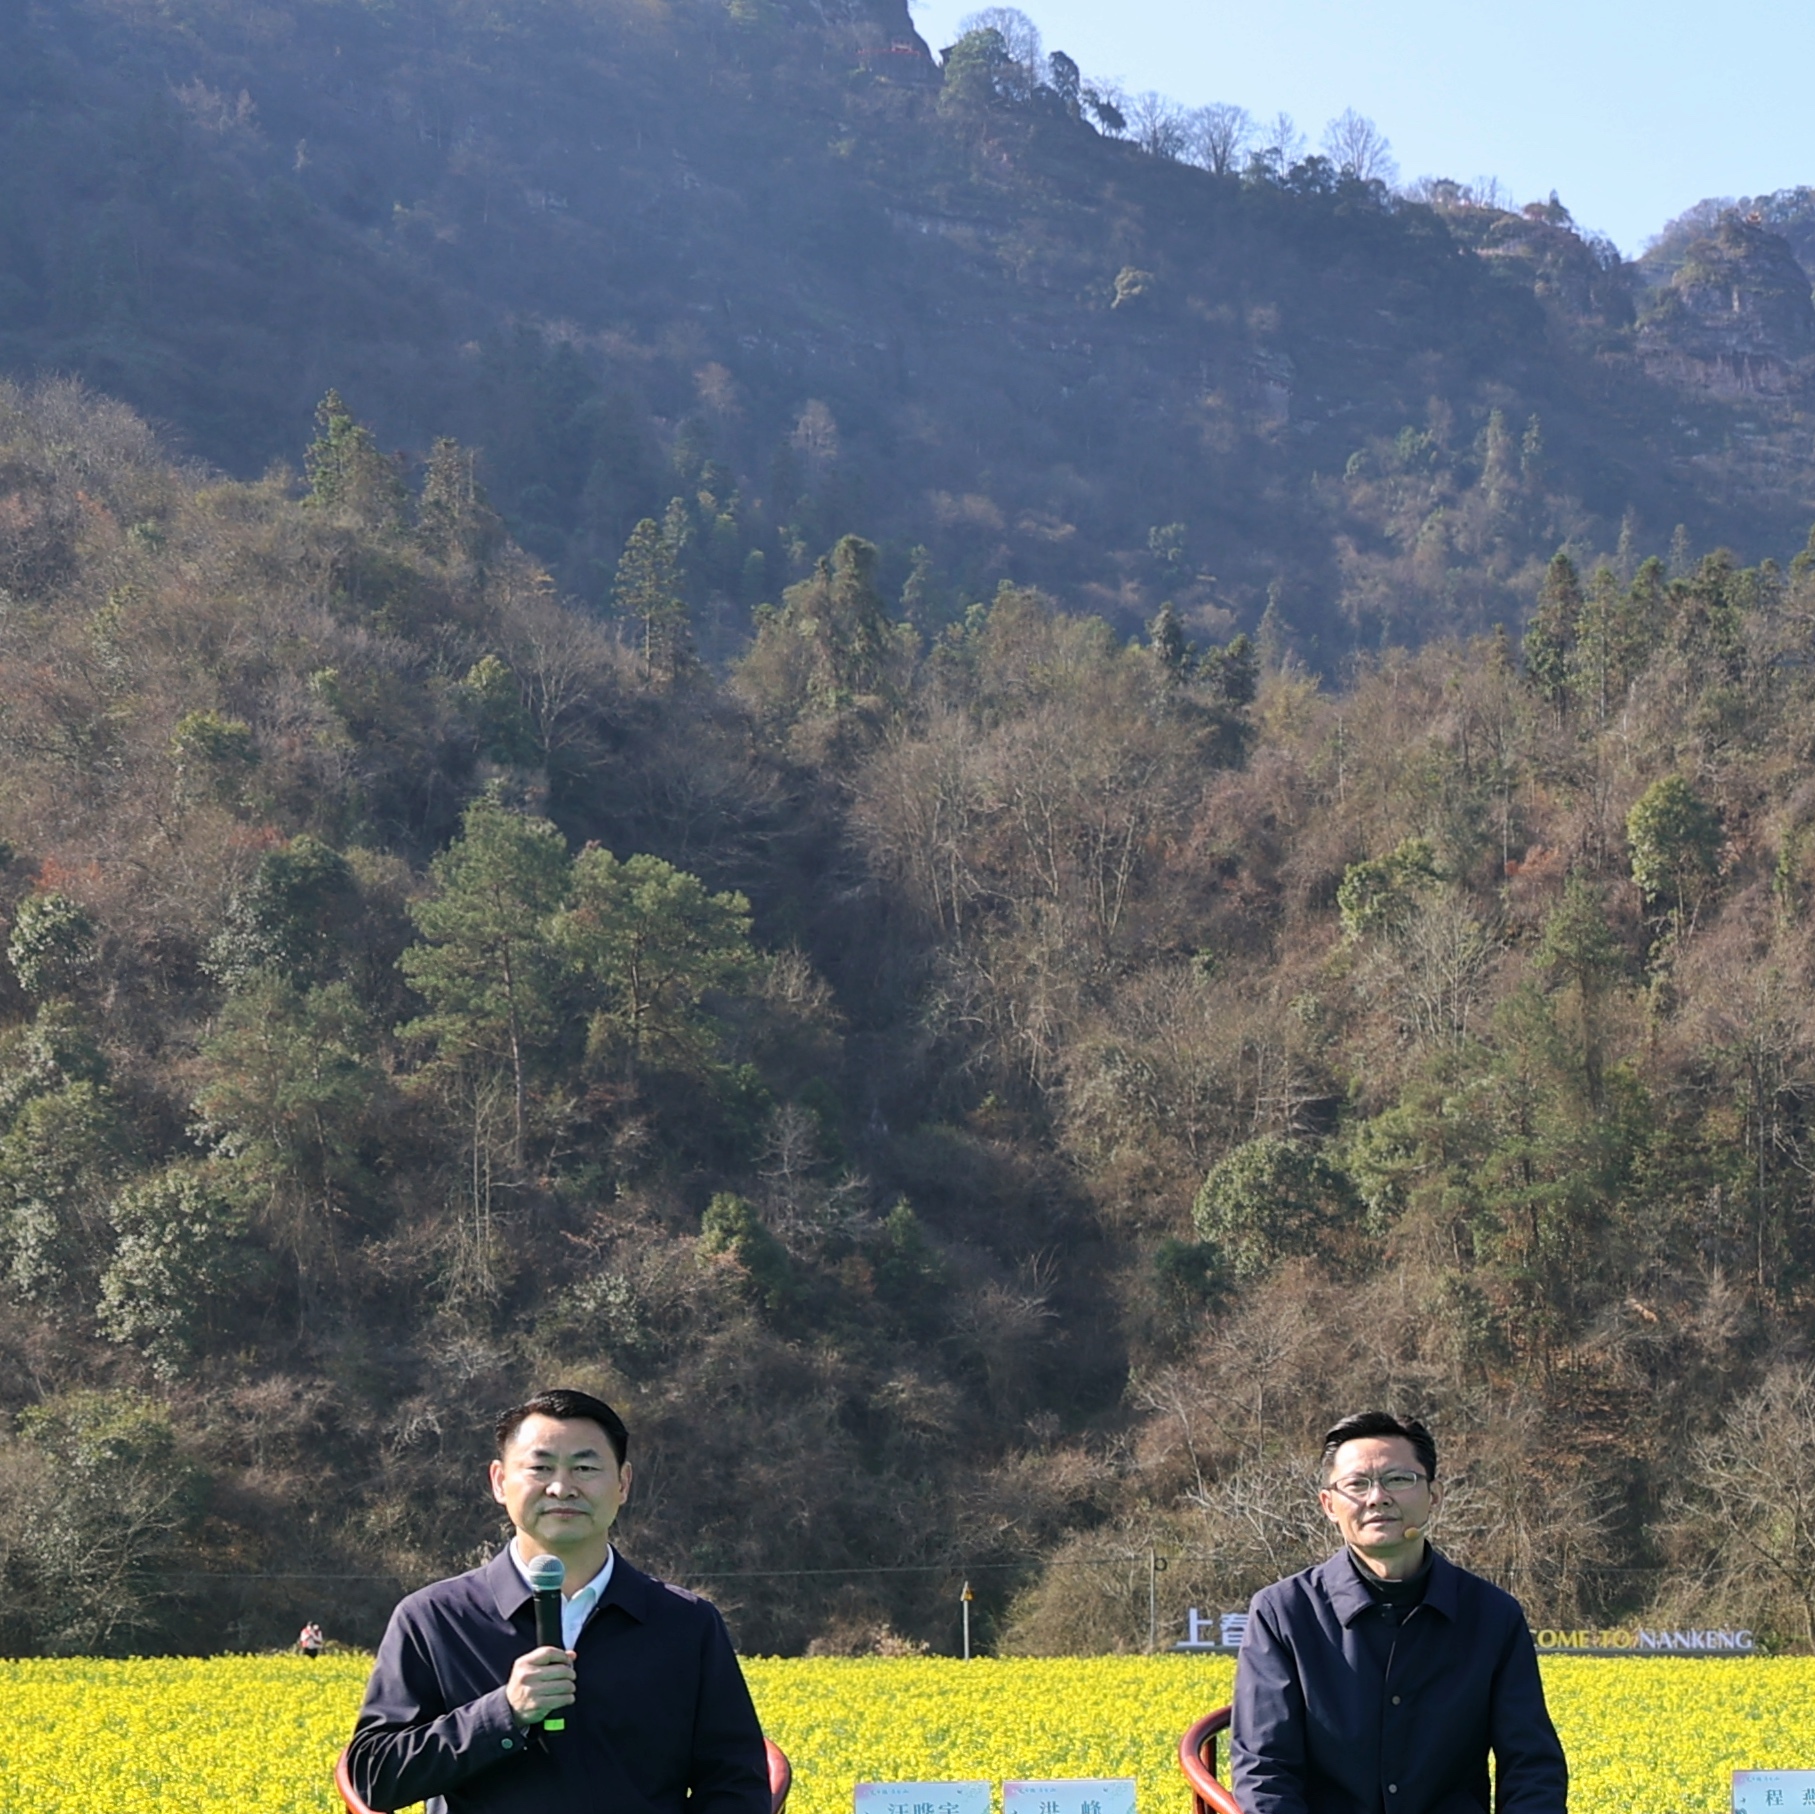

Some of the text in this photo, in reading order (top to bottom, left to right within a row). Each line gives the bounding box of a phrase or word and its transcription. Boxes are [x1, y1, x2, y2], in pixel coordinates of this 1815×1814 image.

[1529, 1629, 1753, 1649] OME TO NANKENG
